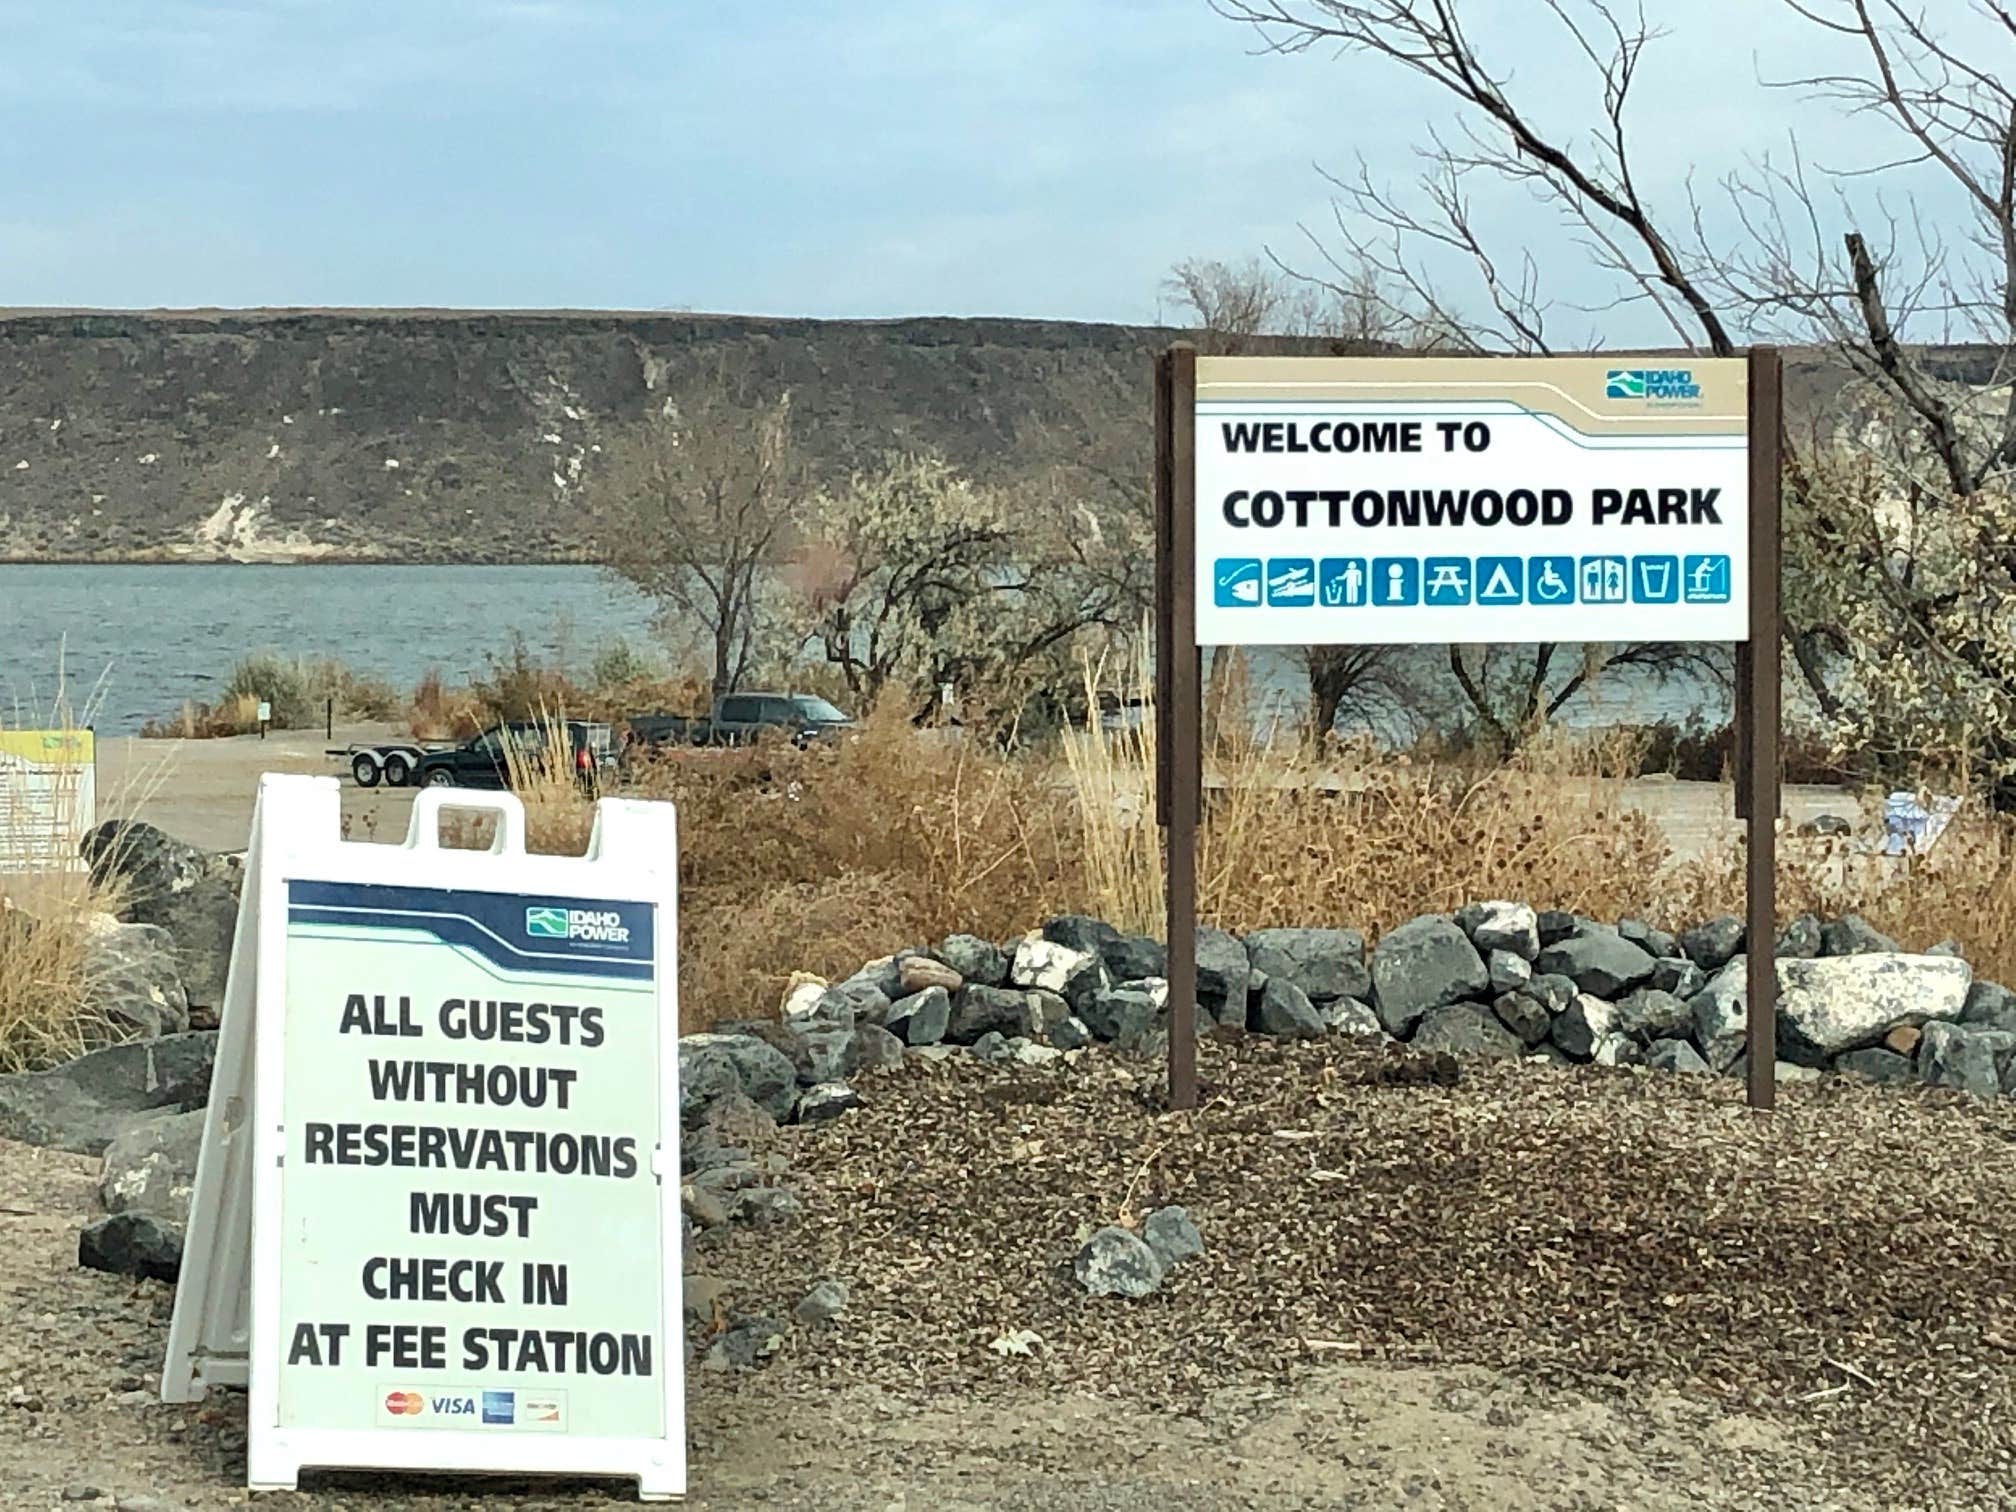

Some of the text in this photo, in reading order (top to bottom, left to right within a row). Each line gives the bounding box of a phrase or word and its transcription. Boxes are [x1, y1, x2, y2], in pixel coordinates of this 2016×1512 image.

[1645, 371, 1691, 384] IDAHO
[1645, 384, 1701, 398] POWER
[1222, 421, 1491, 453] WELCOME TO
[1222, 488, 1723, 528] COTTONWOOD PARK
[569, 910, 619, 927] IDAHO
[569, 924, 629, 942] POWER
[339, 994, 605, 1048] ALL GUESTS
[368, 1059, 577, 1110] WITHOUT
[305, 1122, 637, 1179] RESERVATIONS
[410, 1192, 538, 1238] MUST
[362, 1256, 568, 1306] CHECK IN
[288, 1323, 652, 1377] AT FEE STATION
[432, 1398, 475, 1415] VISA
